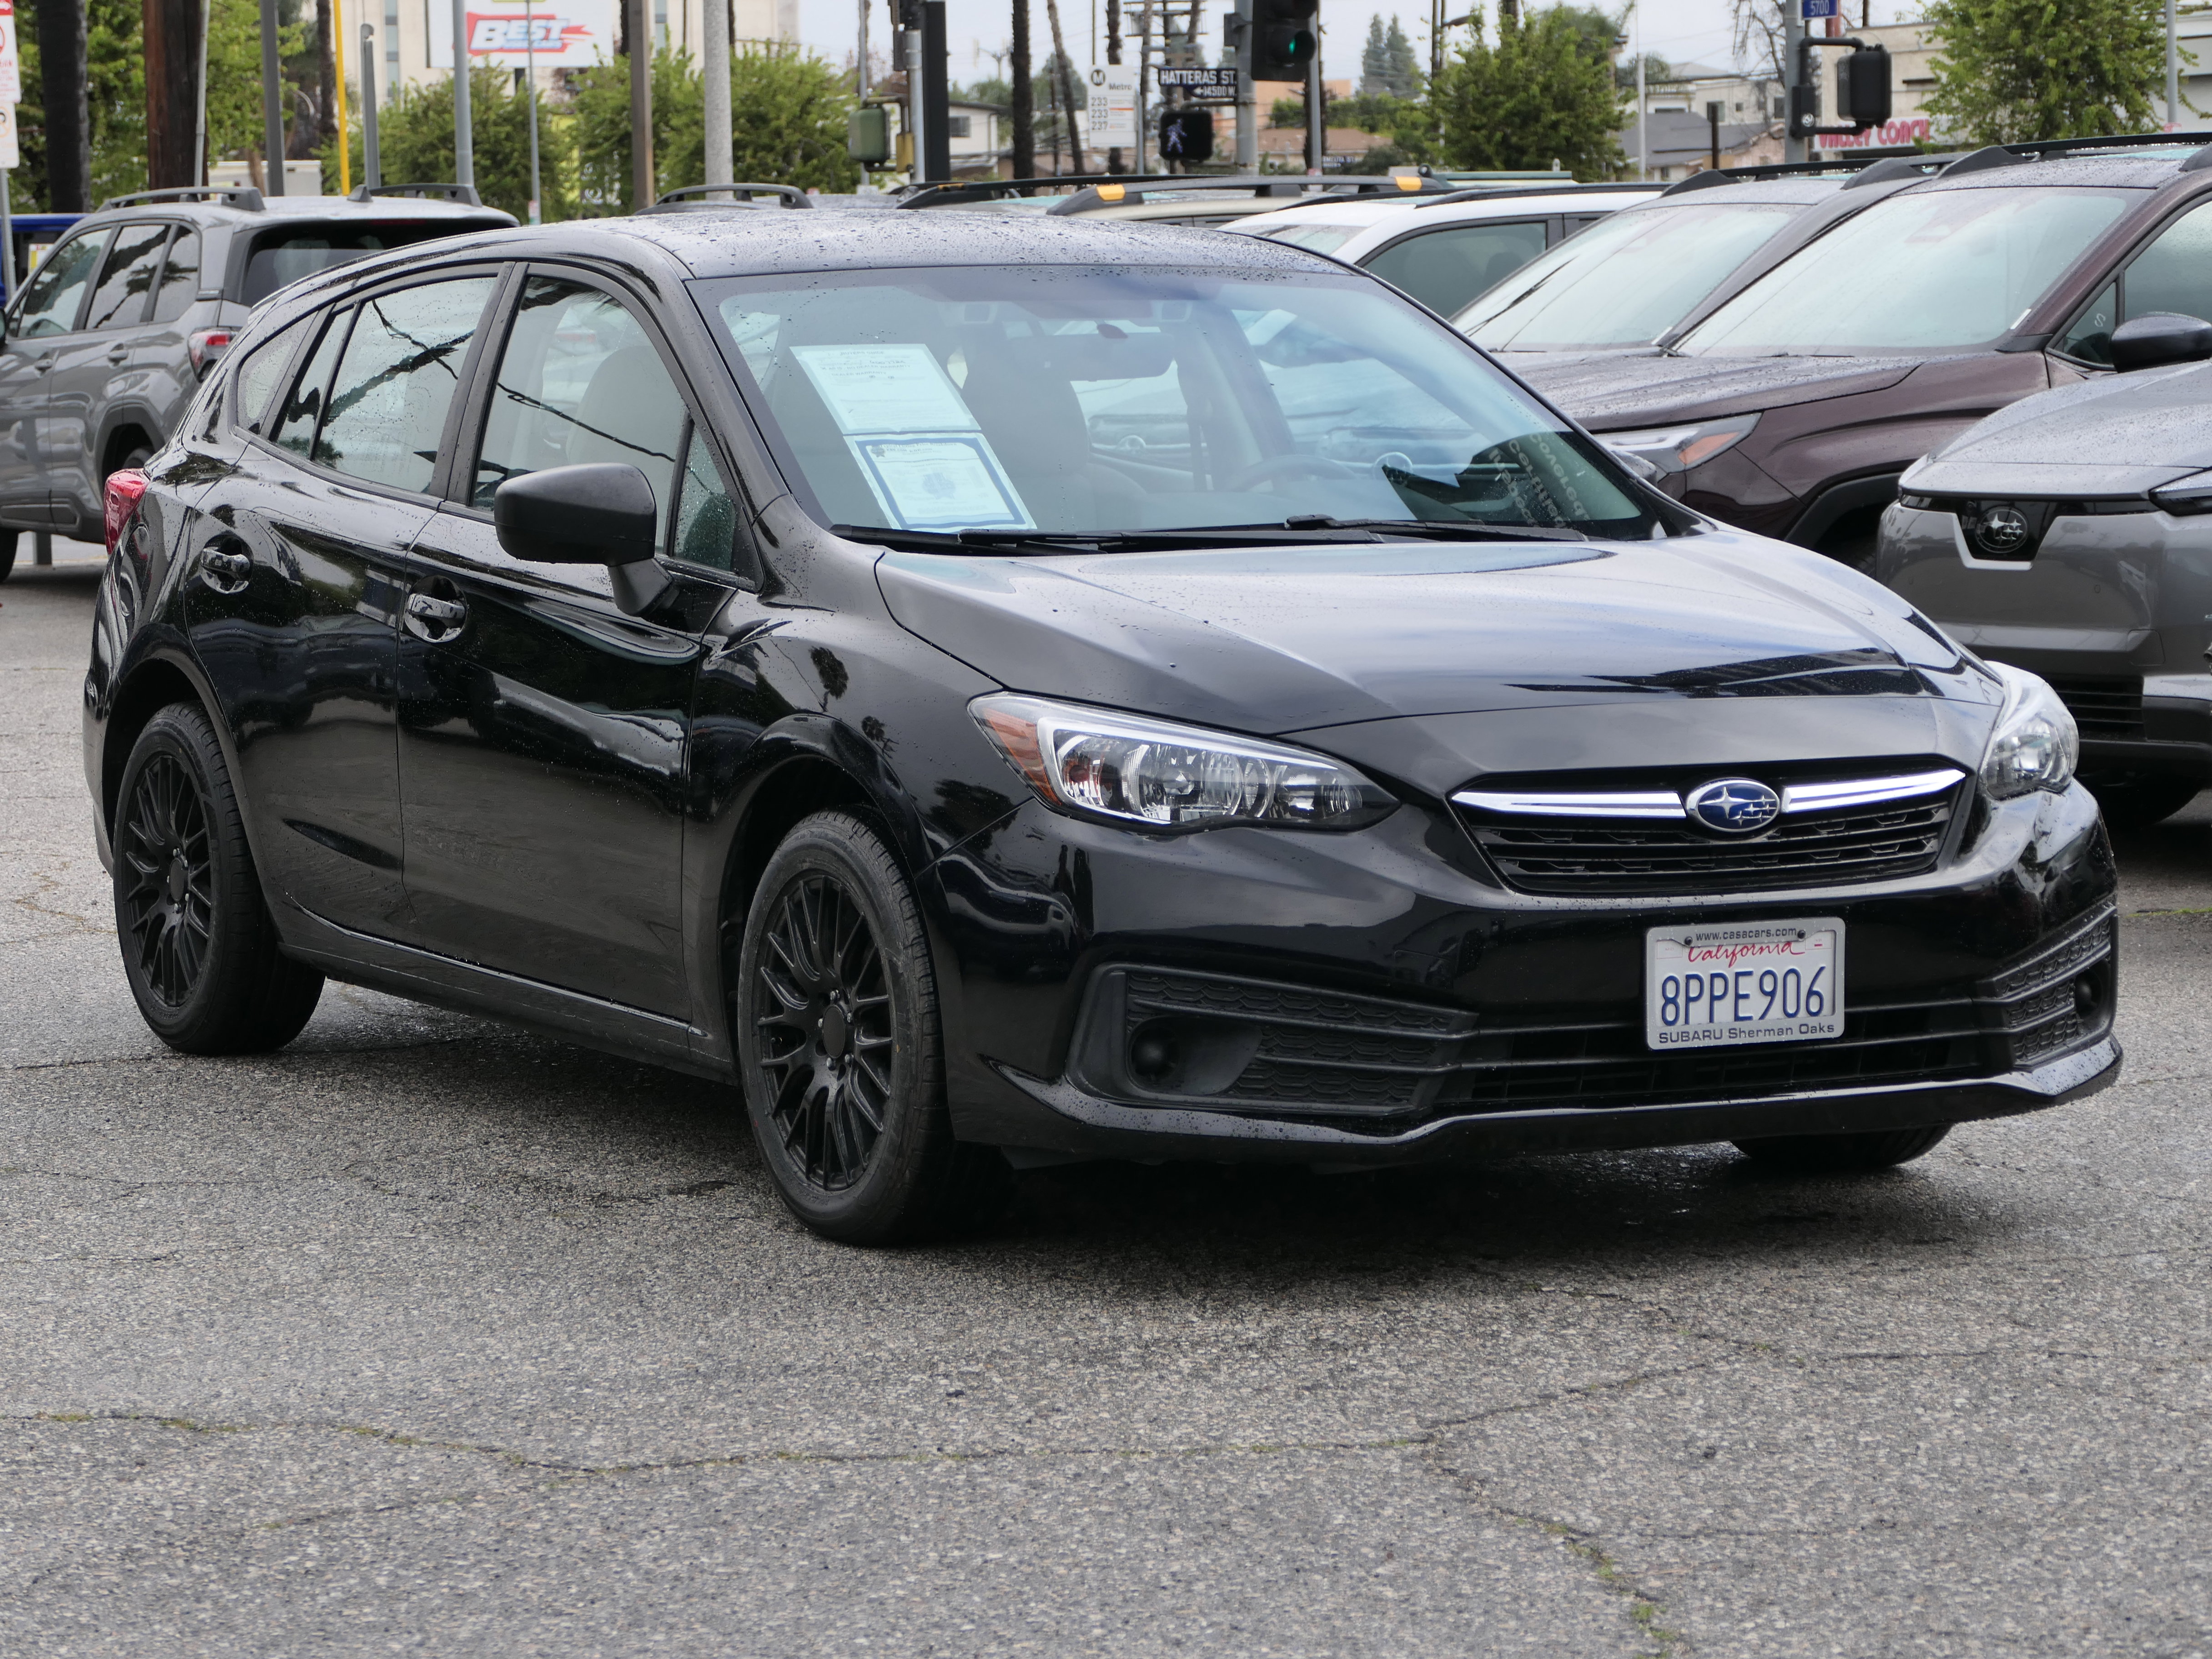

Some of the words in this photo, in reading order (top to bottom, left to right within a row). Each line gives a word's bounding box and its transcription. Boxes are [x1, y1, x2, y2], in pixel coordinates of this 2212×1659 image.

[1810, 0, 1830, 15] 5700
[470, 19, 570, 50] BEST
[1160, 70, 1217, 84] HATTERAS
[1203, 86, 1227, 96] 14500
[1091, 97, 1108, 106] 233
[1091, 109, 1108, 118] 233
[1092, 121, 1108, 131] 237
[1877, 119, 1930, 146] COACH
[1696, 927, 1797, 941] www.casacars.com
[1688, 941, 1806, 968] California
[1661, 966, 1826, 1026] 8PPE906
[1659, 1029, 1723, 1044] SUBARU
[1728, 1024, 1793, 1039] Sherman
[1799, 1022, 1834, 1035] Oaks
